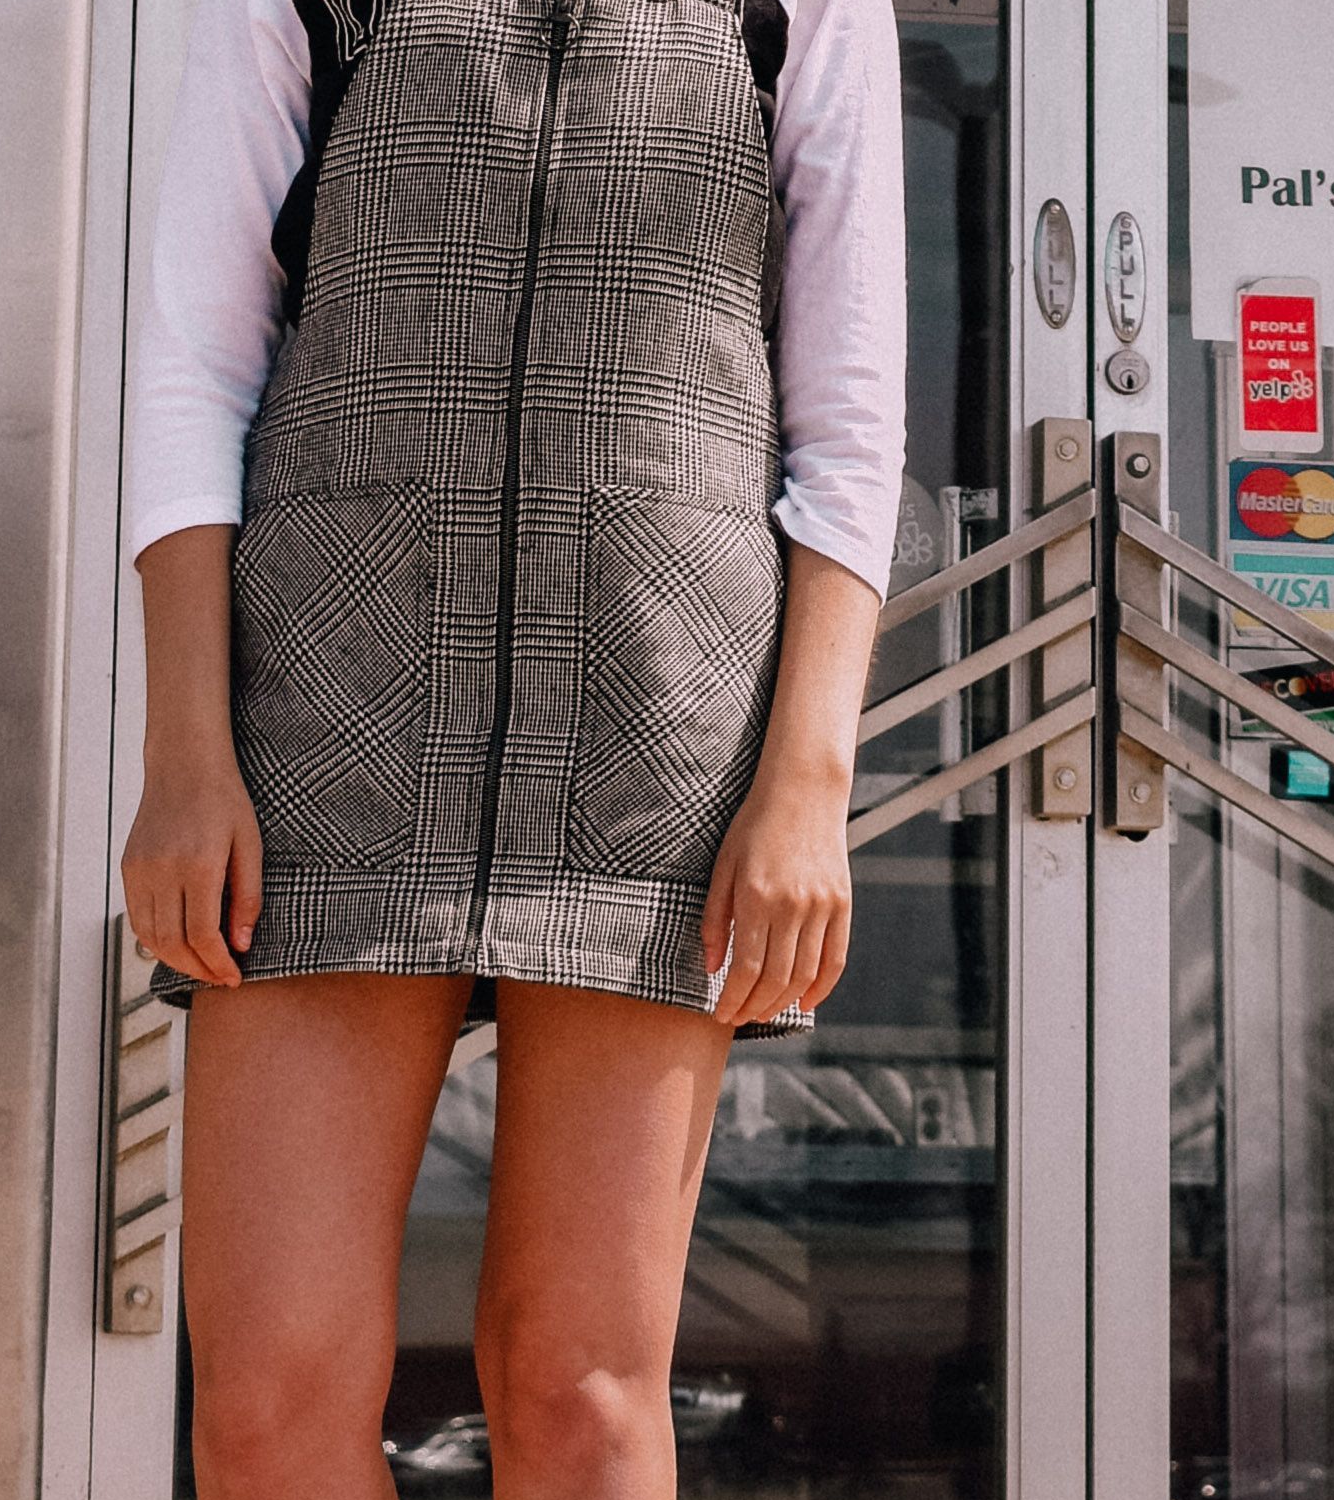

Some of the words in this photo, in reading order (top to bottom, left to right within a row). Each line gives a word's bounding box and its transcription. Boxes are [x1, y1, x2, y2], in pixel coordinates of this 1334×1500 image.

[1119, 231, 1135, 325] PULL
[1249, 320, 1307, 334] PEOPLE
[1248, 339, 1287, 351] LOVE
[1290, 340, 1310, 352] US
[1267, 358, 1291, 370] ON
[1248, 379, 1293, 402] yelp
[1252, 576, 1331, 609] VISA
